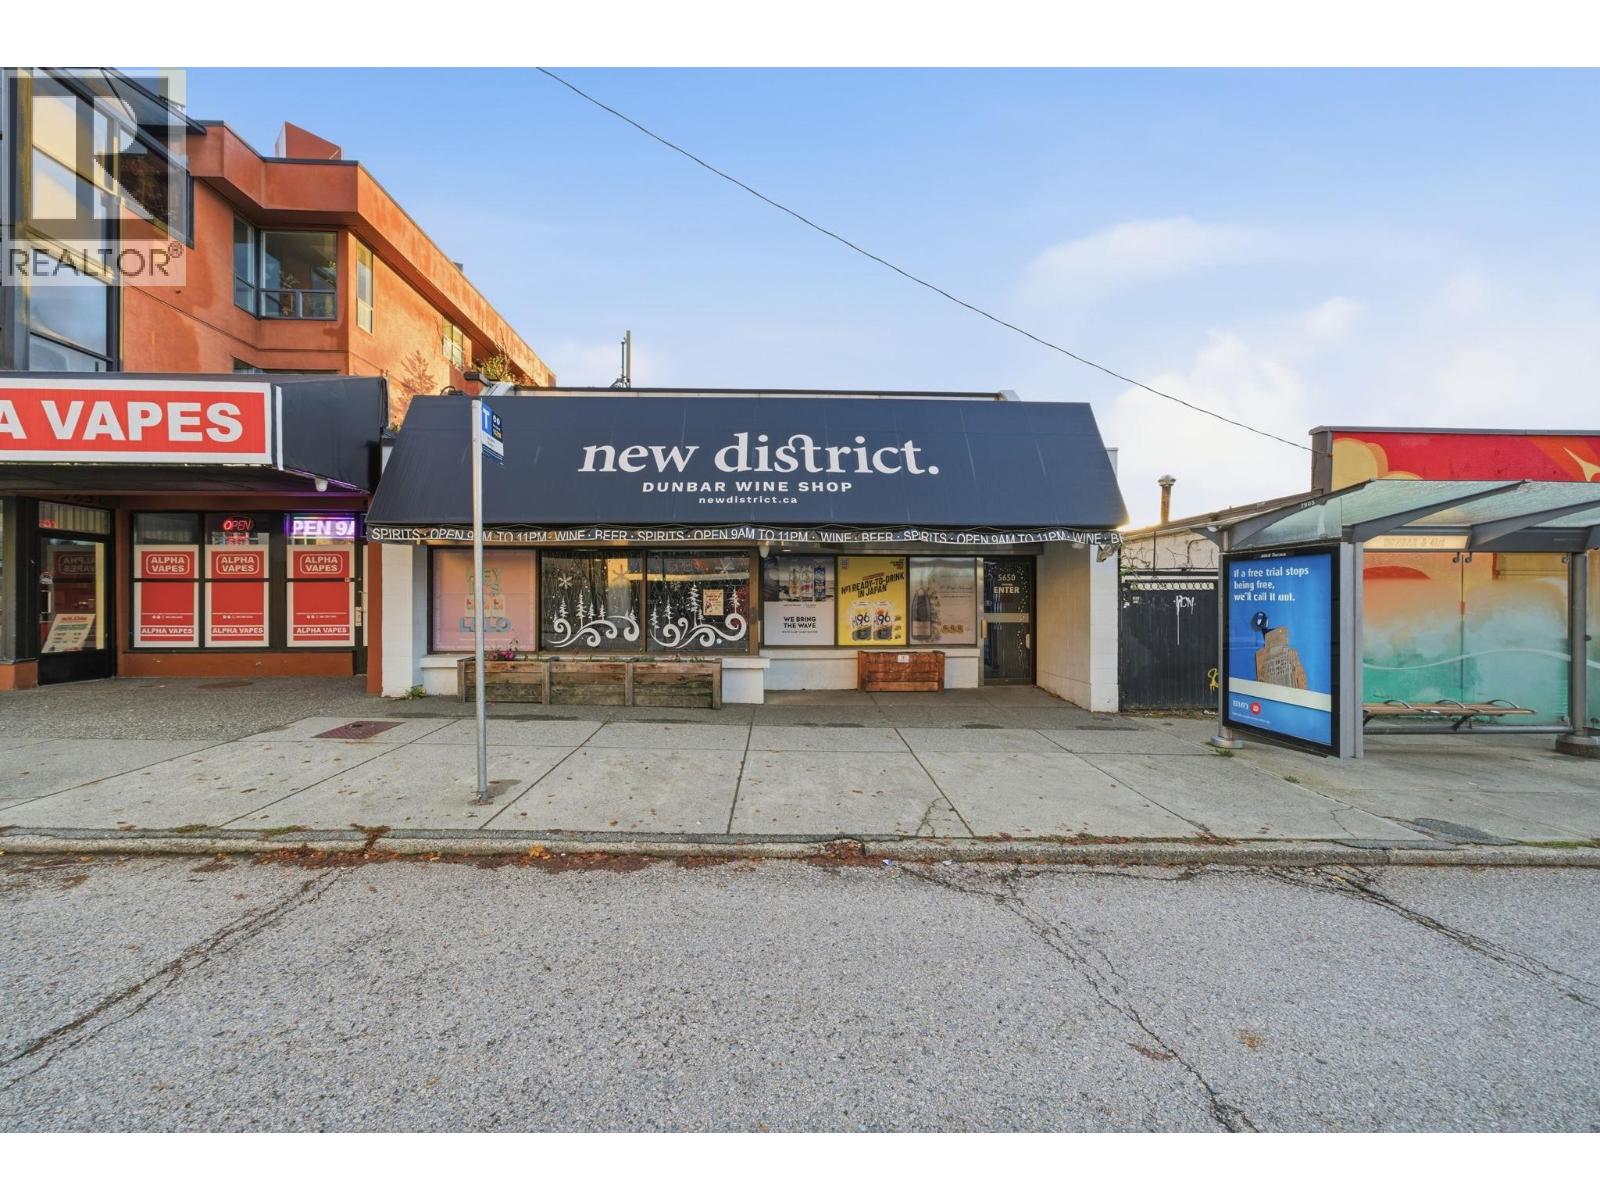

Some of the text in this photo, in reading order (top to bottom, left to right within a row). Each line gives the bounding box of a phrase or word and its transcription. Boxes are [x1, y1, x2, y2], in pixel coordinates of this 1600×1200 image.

[41, 400, 243, 443] VAPES
[578, 431, 940, 475] new district.
[642, 481, 852, 493] DUNBAR WINE SHOP
[698, 496, 798, 504] newdistrict.ca
[223, 520, 252, 531] OPEN
[371, 528, 421, 540] SPIRITS
[430, 528, 464, 540] OPEN
[467, 530, 492, 541] 9M
[497, 531, 513, 542] TO
[517, 532, 547, 542] 11PM
[555, 530, 585, 540] WINE
[595, 530, 627, 541] BEER
[637, 531, 684, 541] SPIRITS
[694, 529, 728, 540] OPEN
[731, 527, 755, 540] 9AM
[758, 529, 775, 540] TO
[778, 531, 808, 542] 11PM
[821, 531, 852, 542] WINE
[862, 531, 893, 542] BEER
[903, 530, 947, 543] SPIRITS
[957, 533, 989, 544] OPEN
[991, 534, 1015, 544] 9AM
[1018, 533, 1034, 543] TO
[1037, 530, 1067, 541] 11PM
[1073, 532, 1101, 544] WINE
[151, 556, 185, 564] ALPHA
[221, 556, 255, 564] ALPHA
[304, 556, 338, 564] ALPHA
[151, 565, 185, 573] VAPES
[221, 564, 255, 572] VAPES
[305, 564, 338, 572] VAPES
[1247, 568, 1264, 577] free
[1266, 565, 1283, 577] trial
[1285, 566, 1310, 577] stops
[997, 573, 1016, 581] 5650
[1233, 580, 1275, 591] being free,
[865, 583, 887, 597] JAPAN
[993, 586, 1020, 594] ENTER
[1253, 592, 1267, 601] call
